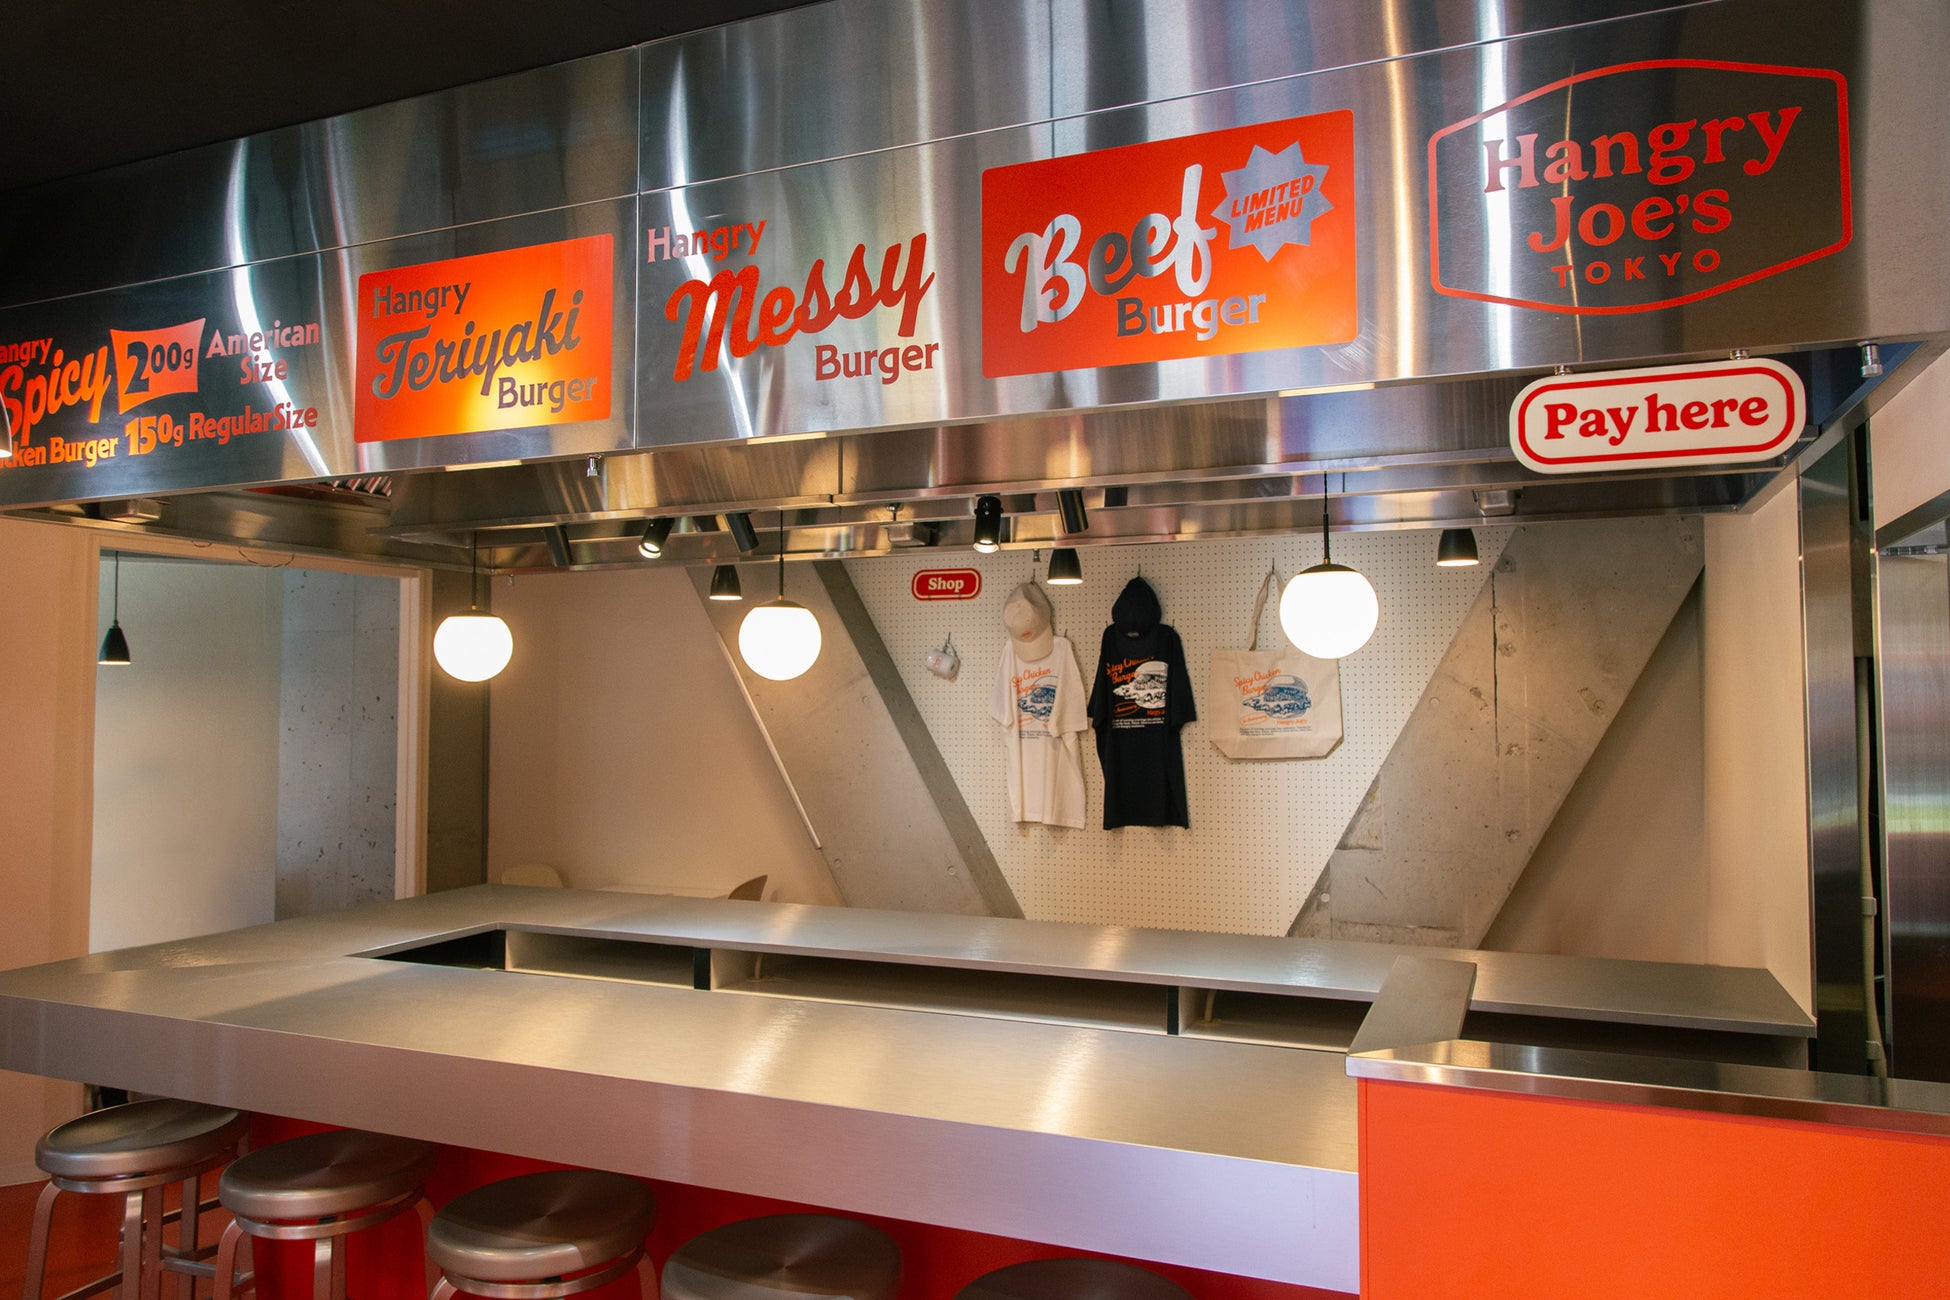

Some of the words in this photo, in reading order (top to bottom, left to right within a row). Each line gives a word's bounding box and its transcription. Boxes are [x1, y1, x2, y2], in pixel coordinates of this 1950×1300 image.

[1483, 106, 1802, 193] Hangry
[1230, 174, 1315, 218] LIMITED
[1244, 197, 1304, 233] MENU
[647, 220, 767, 263] Hangry
[1527, 189, 1732, 253] Joe's
[1004, 164, 1217, 333] Beef
[1551, 248, 1720, 288] TOKYO
[373, 282, 471, 318] Hangry
[665, 232, 936, 382] Messy
[1116, 293, 1266, 341] Burger
[0, 338, 53, 368] angry
[205, 320, 320, 359] American
[372, 288, 584, 399] Teriyaki
[124, 341, 193, 395] 200g
[240, 356, 288, 385] Size
[815, 342, 939, 385] Burger
[0, 346, 112, 446] Spicy
[497, 376, 597, 413] Burger
[124, 413, 184, 456] 150g
[189, 405, 273, 444] Regular
[273, 402, 318, 430] Size
[1543, 403, 1639, 447] Pay
[1644, 393, 1769, 433] here
[49, 436, 118, 468] Burger
[928, 577, 964, 592] Shop
